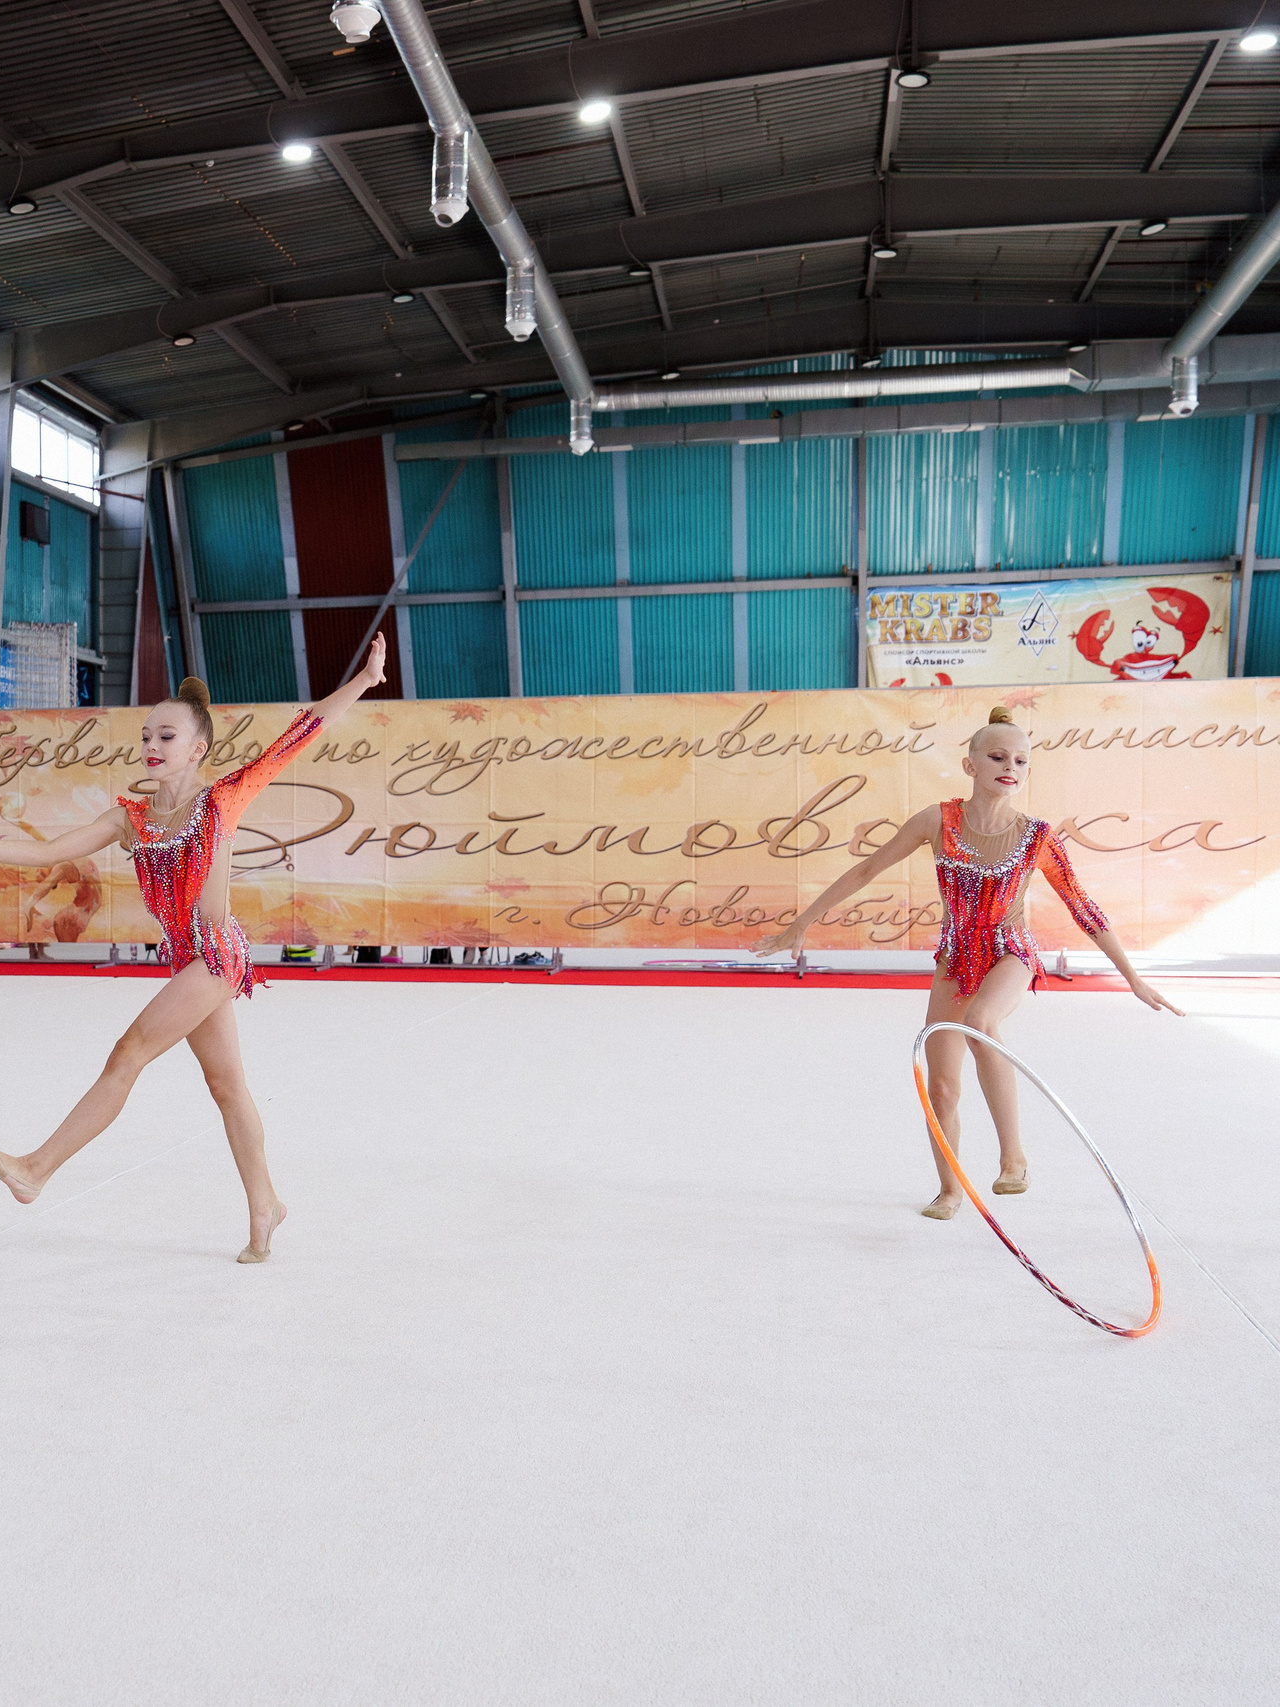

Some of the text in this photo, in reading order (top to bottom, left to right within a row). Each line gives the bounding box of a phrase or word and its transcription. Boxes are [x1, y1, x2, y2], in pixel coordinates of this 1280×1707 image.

[869, 591, 1003, 618] MISTER
[878, 616, 993, 643] KRABS
[312, 738, 381, 764] по
[387, 702, 936, 796] художественной
[494, 904, 542, 925] г.
